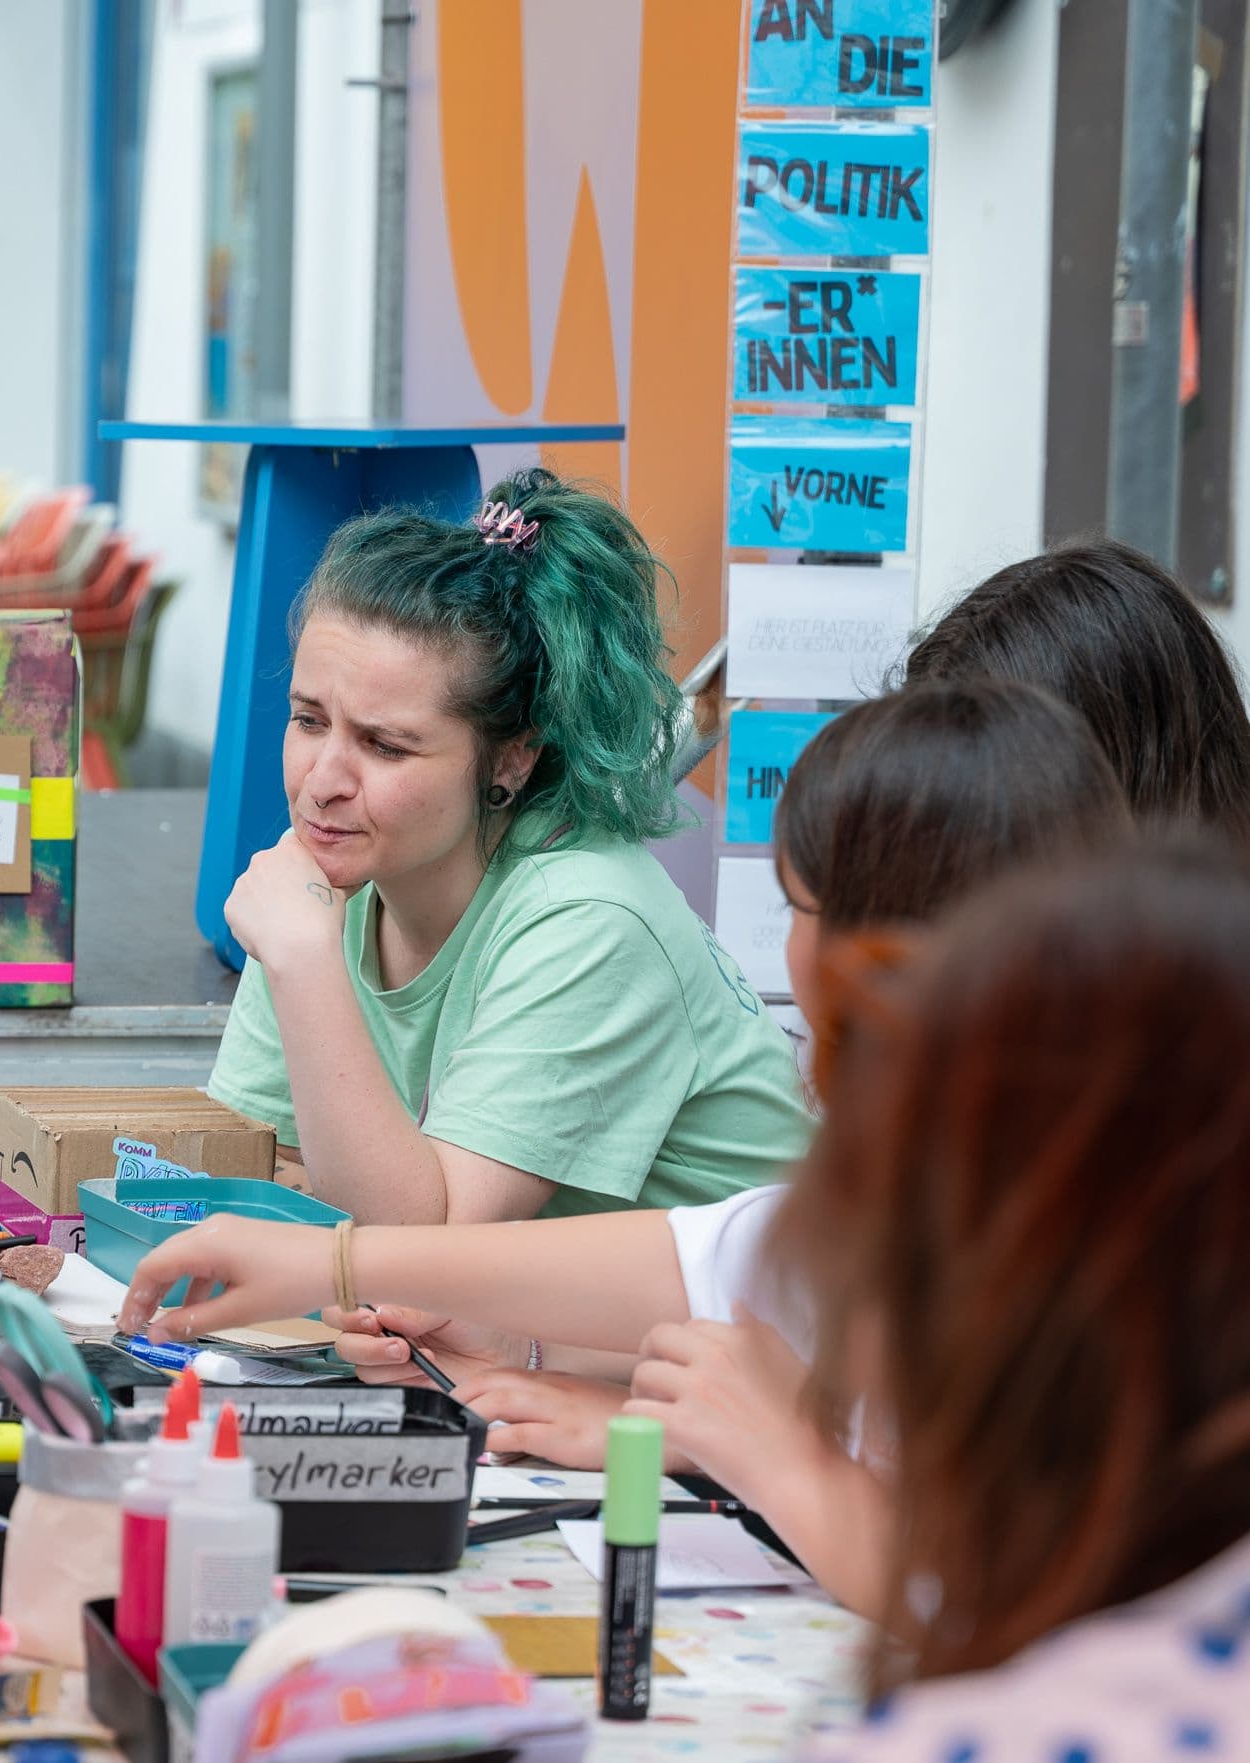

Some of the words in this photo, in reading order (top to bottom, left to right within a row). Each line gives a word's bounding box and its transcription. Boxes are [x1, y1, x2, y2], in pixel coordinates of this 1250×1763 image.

[754, 0, 834, 42] AN
[837, 33, 925, 97] DIE
[744, 155, 925, 221] POLITIK
[746, 335, 898, 392] INNEN
[784, 464, 889, 510] VORNE
[118, 1142, 152, 1158] KOMM
